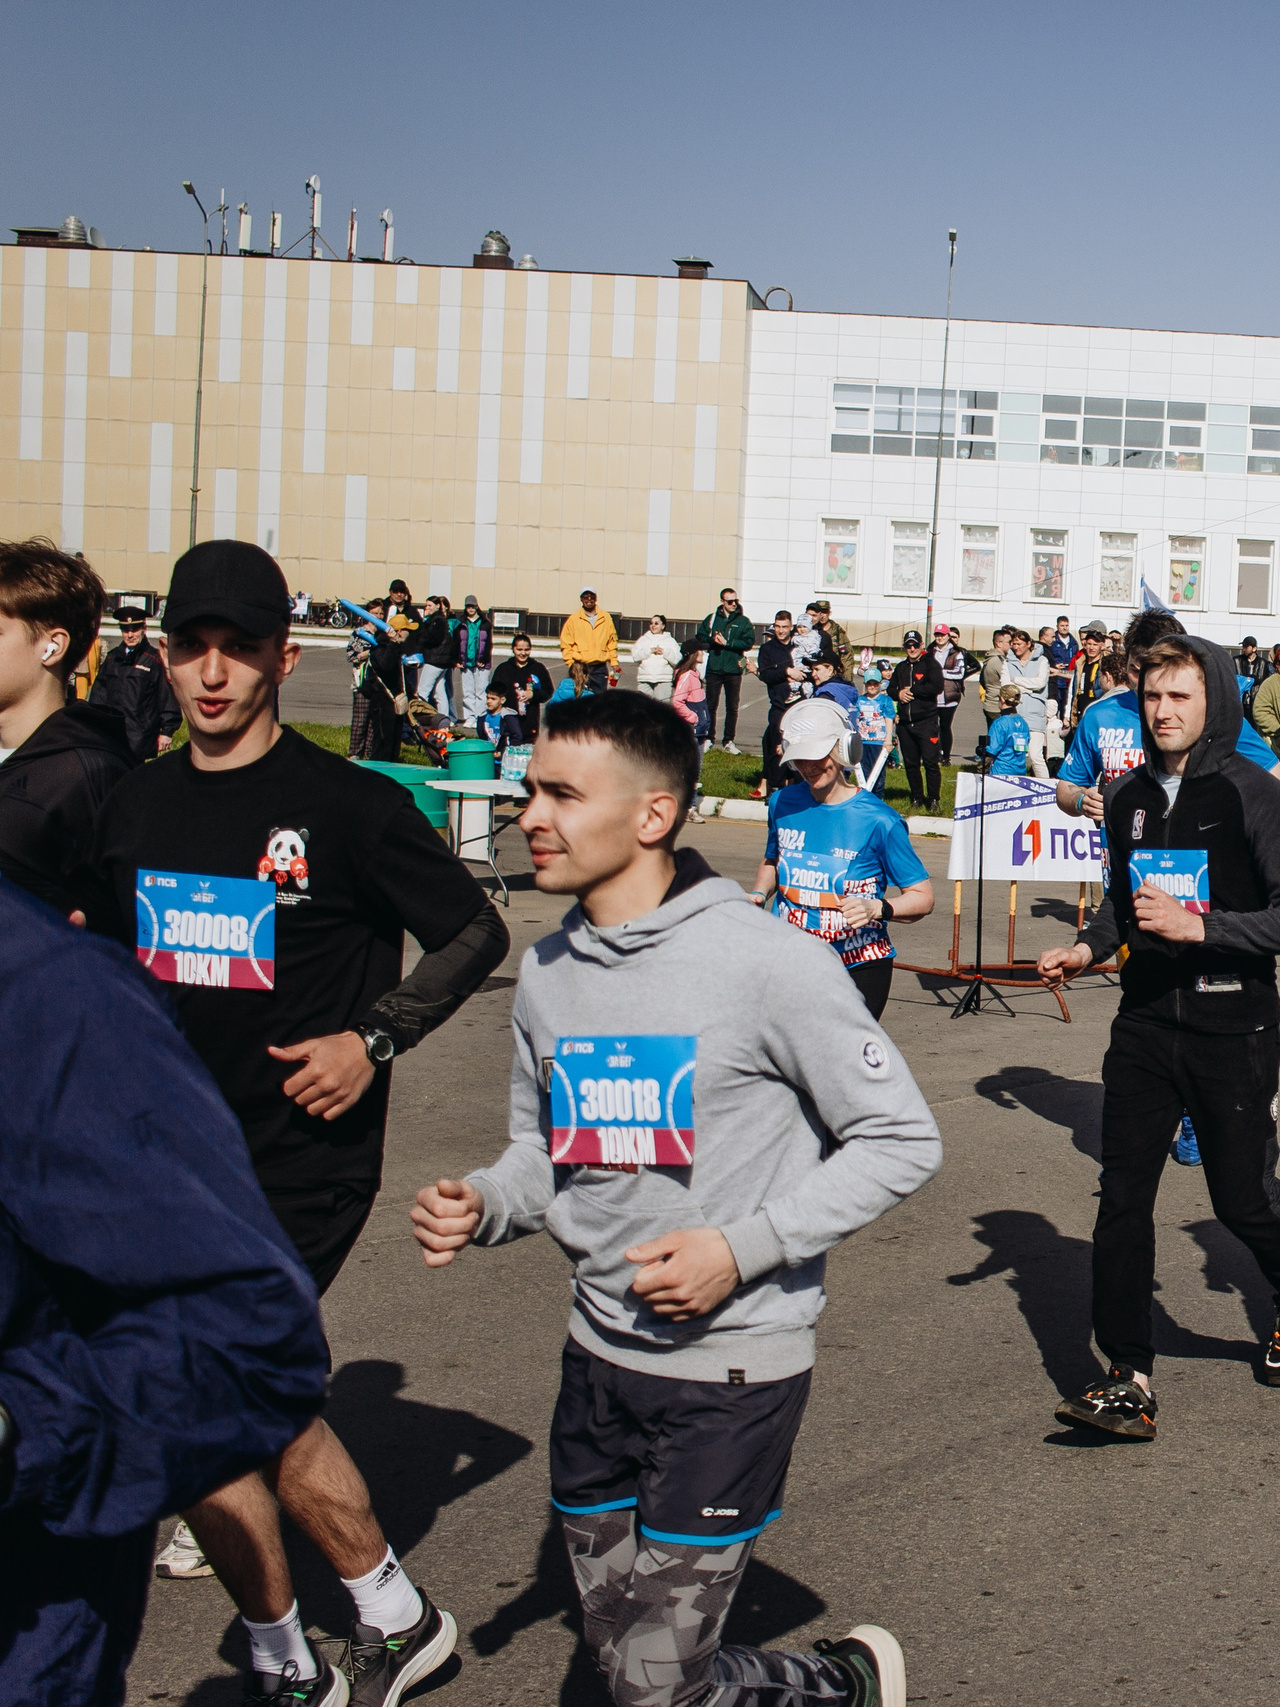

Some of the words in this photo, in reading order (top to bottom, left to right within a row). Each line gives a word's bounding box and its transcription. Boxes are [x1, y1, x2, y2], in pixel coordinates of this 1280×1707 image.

[1098, 728, 1134, 748] 2024
[778, 827, 806, 850] 2024
[1050, 828, 1102, 860] ПСБ
[791, 867, 830, 890] 20021
[163, 908, 249, 952] 30008
[580, 1077, 661, 1122] 30018
